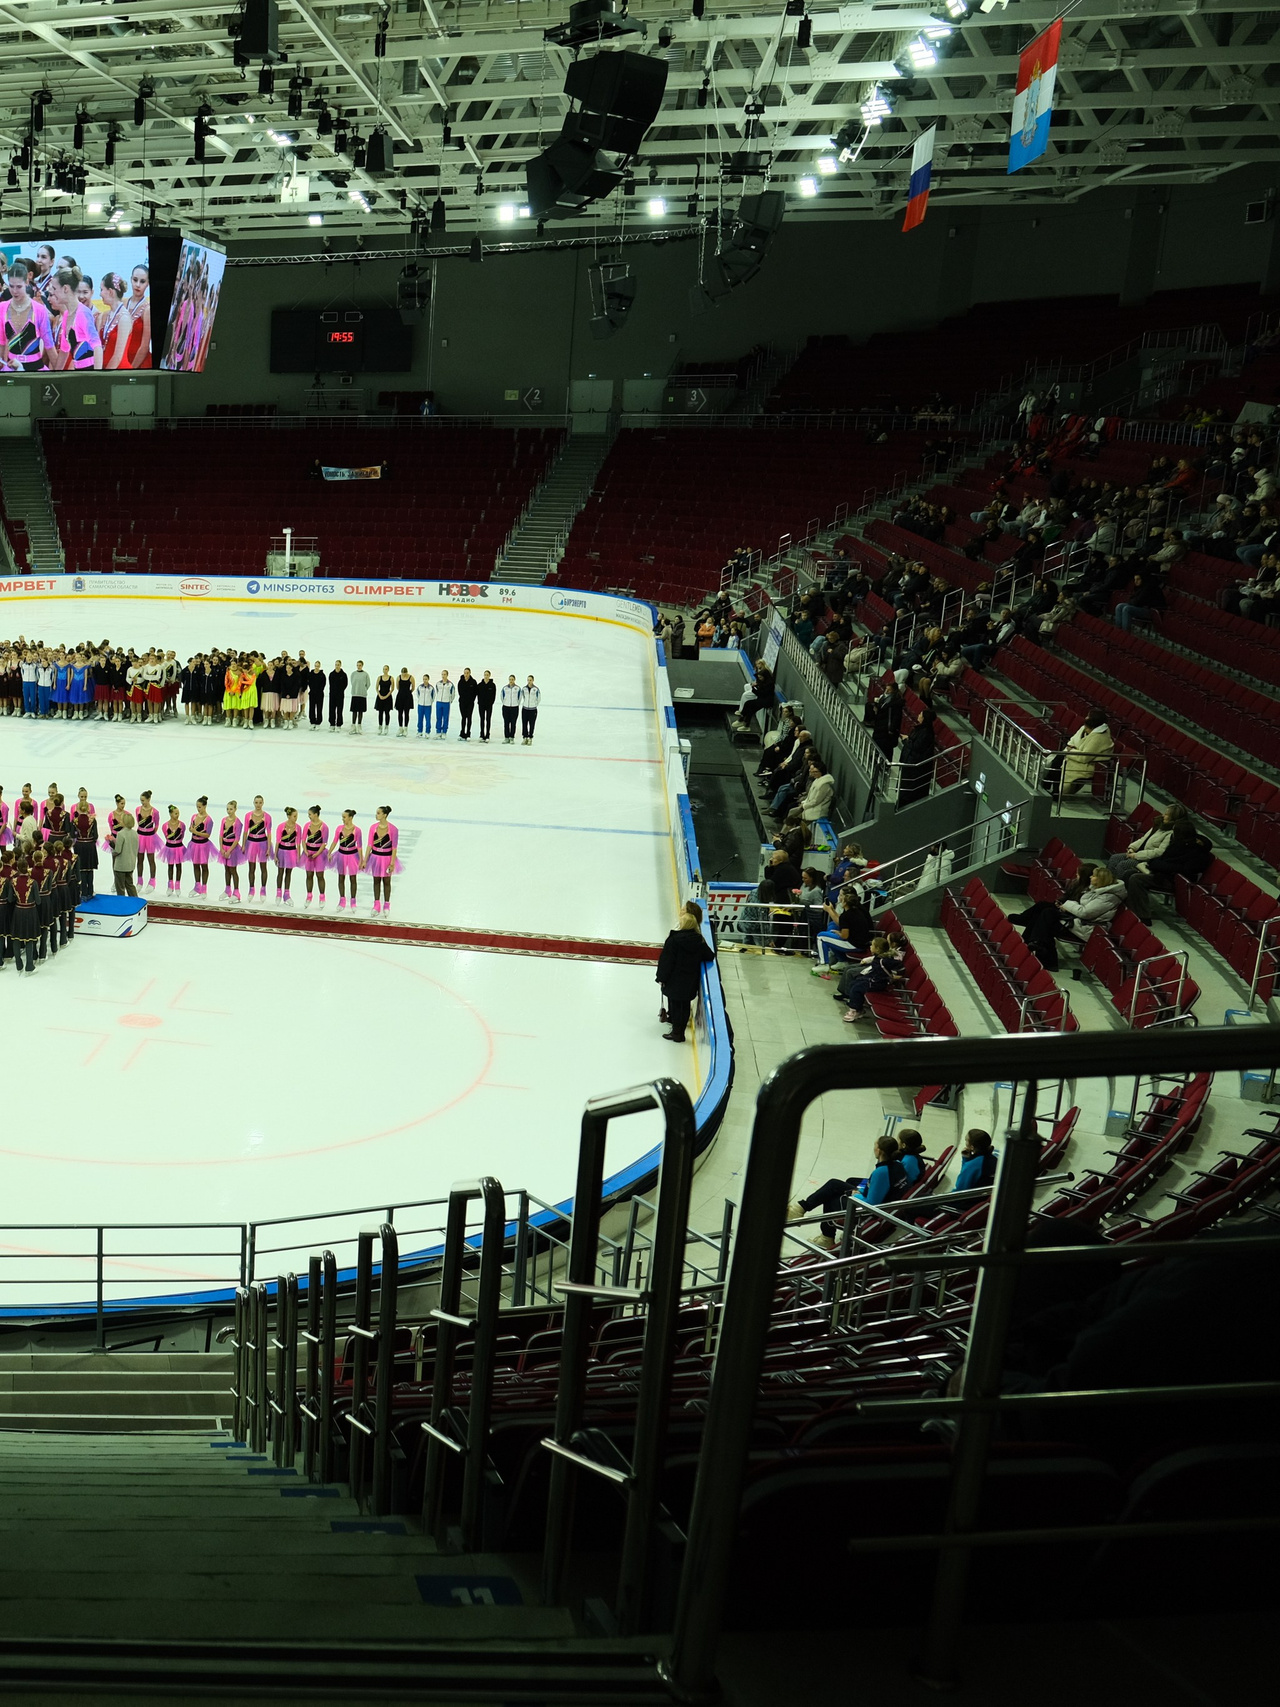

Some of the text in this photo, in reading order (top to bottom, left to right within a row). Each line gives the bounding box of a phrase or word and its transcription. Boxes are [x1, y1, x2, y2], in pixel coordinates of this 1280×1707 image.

[330, 332, 354, 343] 19:55
[180, 583, 210, 591] SINTEC
[262, 583, 335, 594] MINSPORT63
[343, 585, 426, 596] OLIMPBET
[499, 588, 517, 597] 89.6
[502, 596, 513, 604] FM
